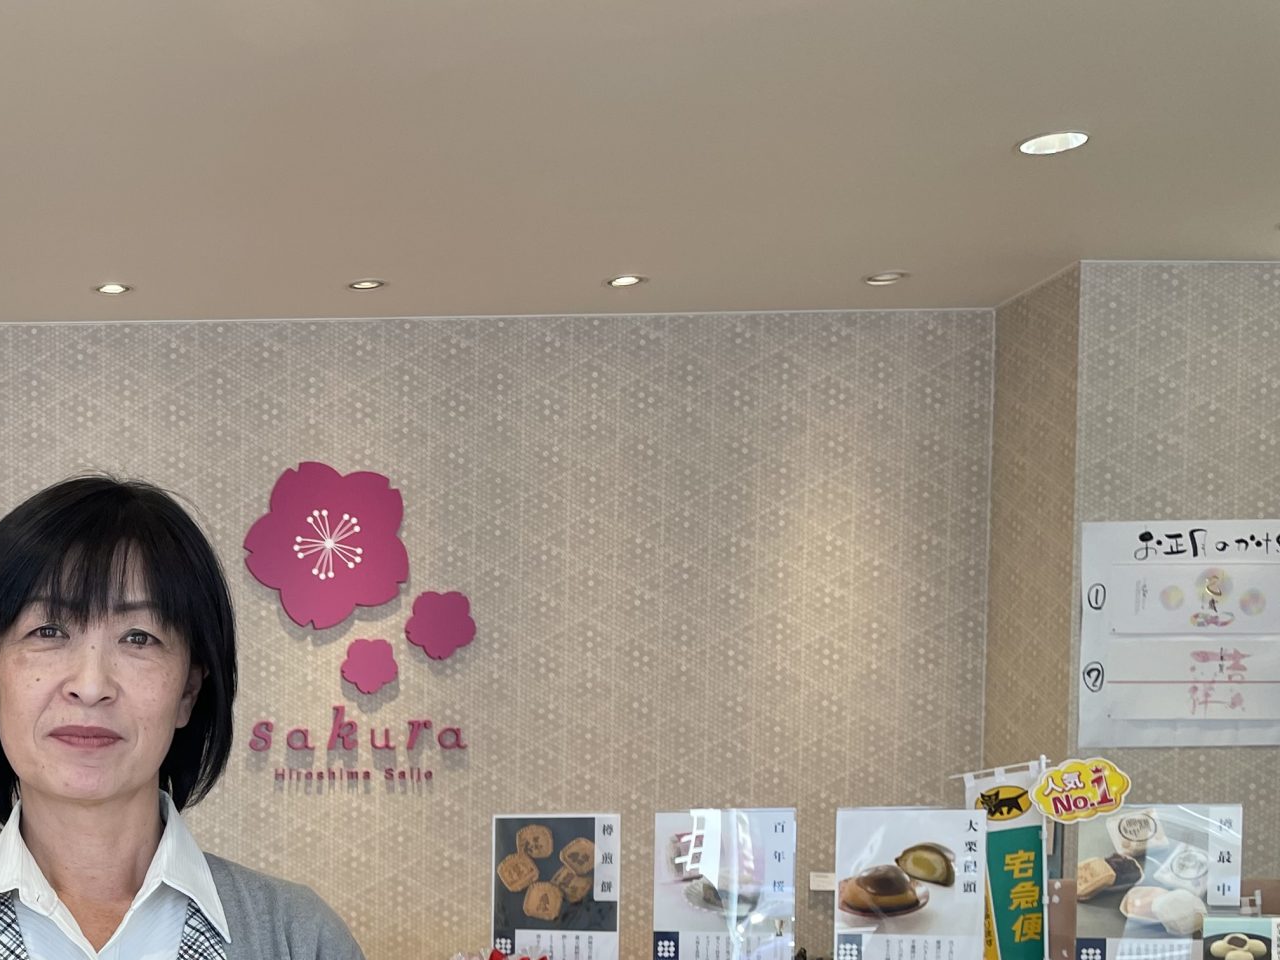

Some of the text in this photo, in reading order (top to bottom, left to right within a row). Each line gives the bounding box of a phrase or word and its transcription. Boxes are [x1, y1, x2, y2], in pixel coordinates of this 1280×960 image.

[249, 706, 467, 751] sakura
[275, 768, 433, 783] Hiroshima Saijo
[1045, 771, 1084, 795] 人気
[1052, 774, 1114, 816] No.1
[600, 821, 614, 893] 樽煎餅
[1004, 850, 1042, 942] 宅急便
